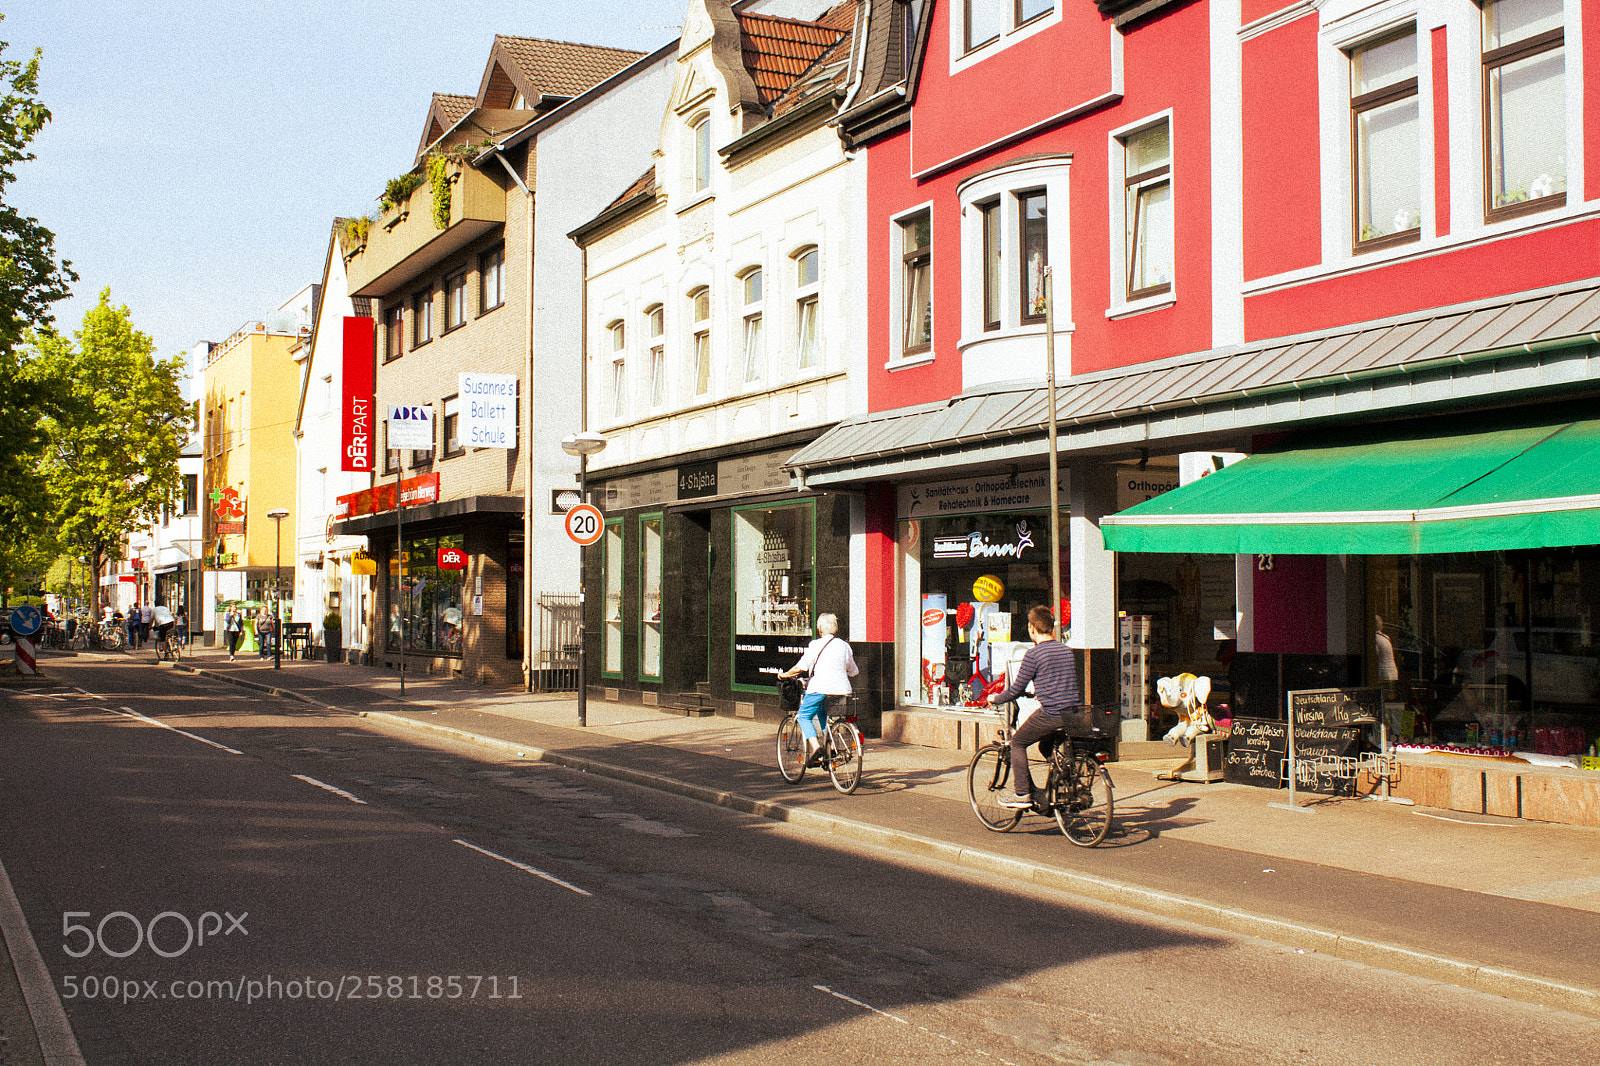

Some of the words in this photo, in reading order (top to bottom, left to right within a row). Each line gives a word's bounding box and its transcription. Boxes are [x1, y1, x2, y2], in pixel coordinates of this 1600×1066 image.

[464, 377, 513, 396] Susanne's
[471, 401, 506, 419] Ballett
[352, 396, 368, 468] DERPART
[471, 427, 506, 443] Schule
[680, 471, 716, 491] 4-Shisha
[939, 497, 982, 511] Rehatechnik
[991, 493, 1030, 506] Homecare
[574, 515, 596, 534] 20
[967, 532, 1017, 558] Binn
[442, 552, 461, 564] DER
[1258, 554, 1274, 570] 23
